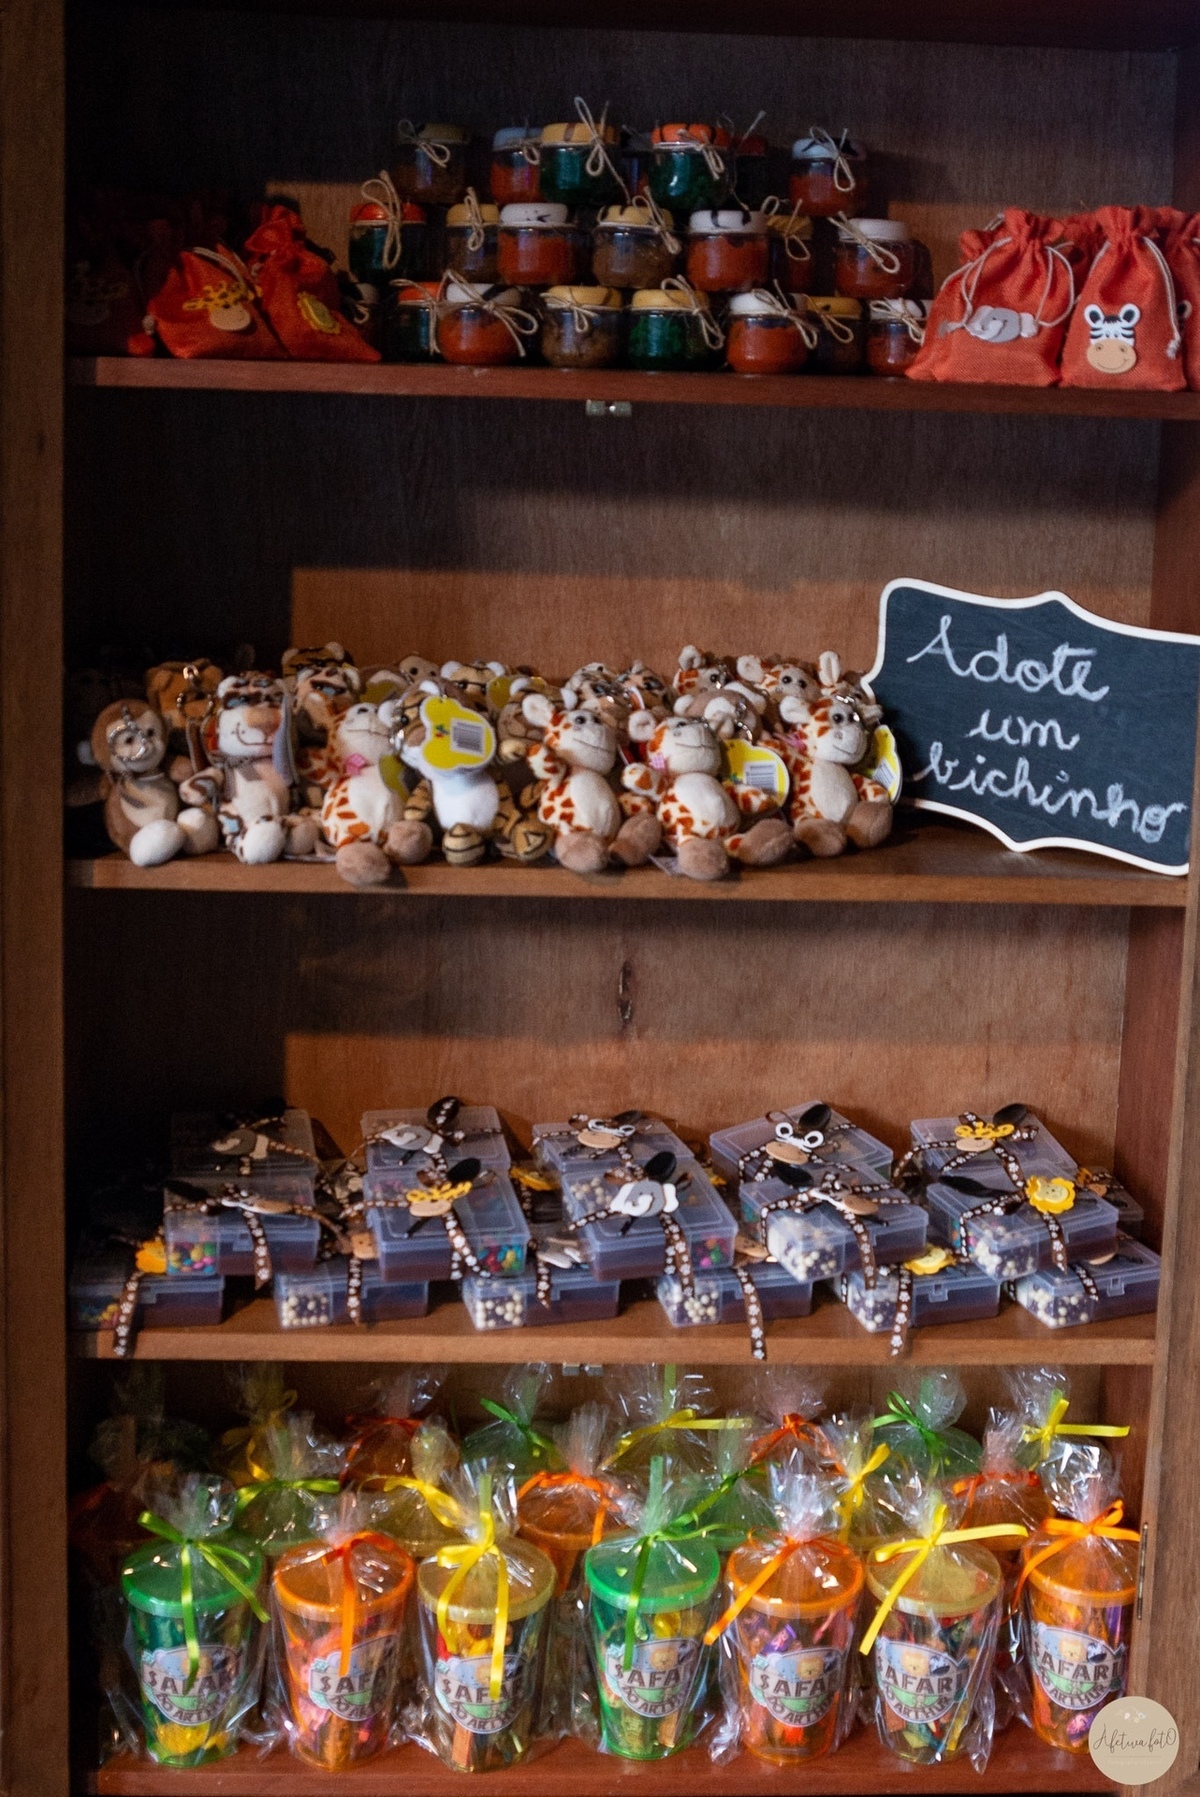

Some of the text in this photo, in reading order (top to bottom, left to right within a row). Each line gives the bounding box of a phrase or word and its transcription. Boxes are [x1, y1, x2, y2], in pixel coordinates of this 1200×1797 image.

[906, 614, 1110, 702] Adote
[964, 708, 1081, 751] um
[615, 1664, 684, 1688] SAFA
[760, 1673, 829, 1697] SAFA
